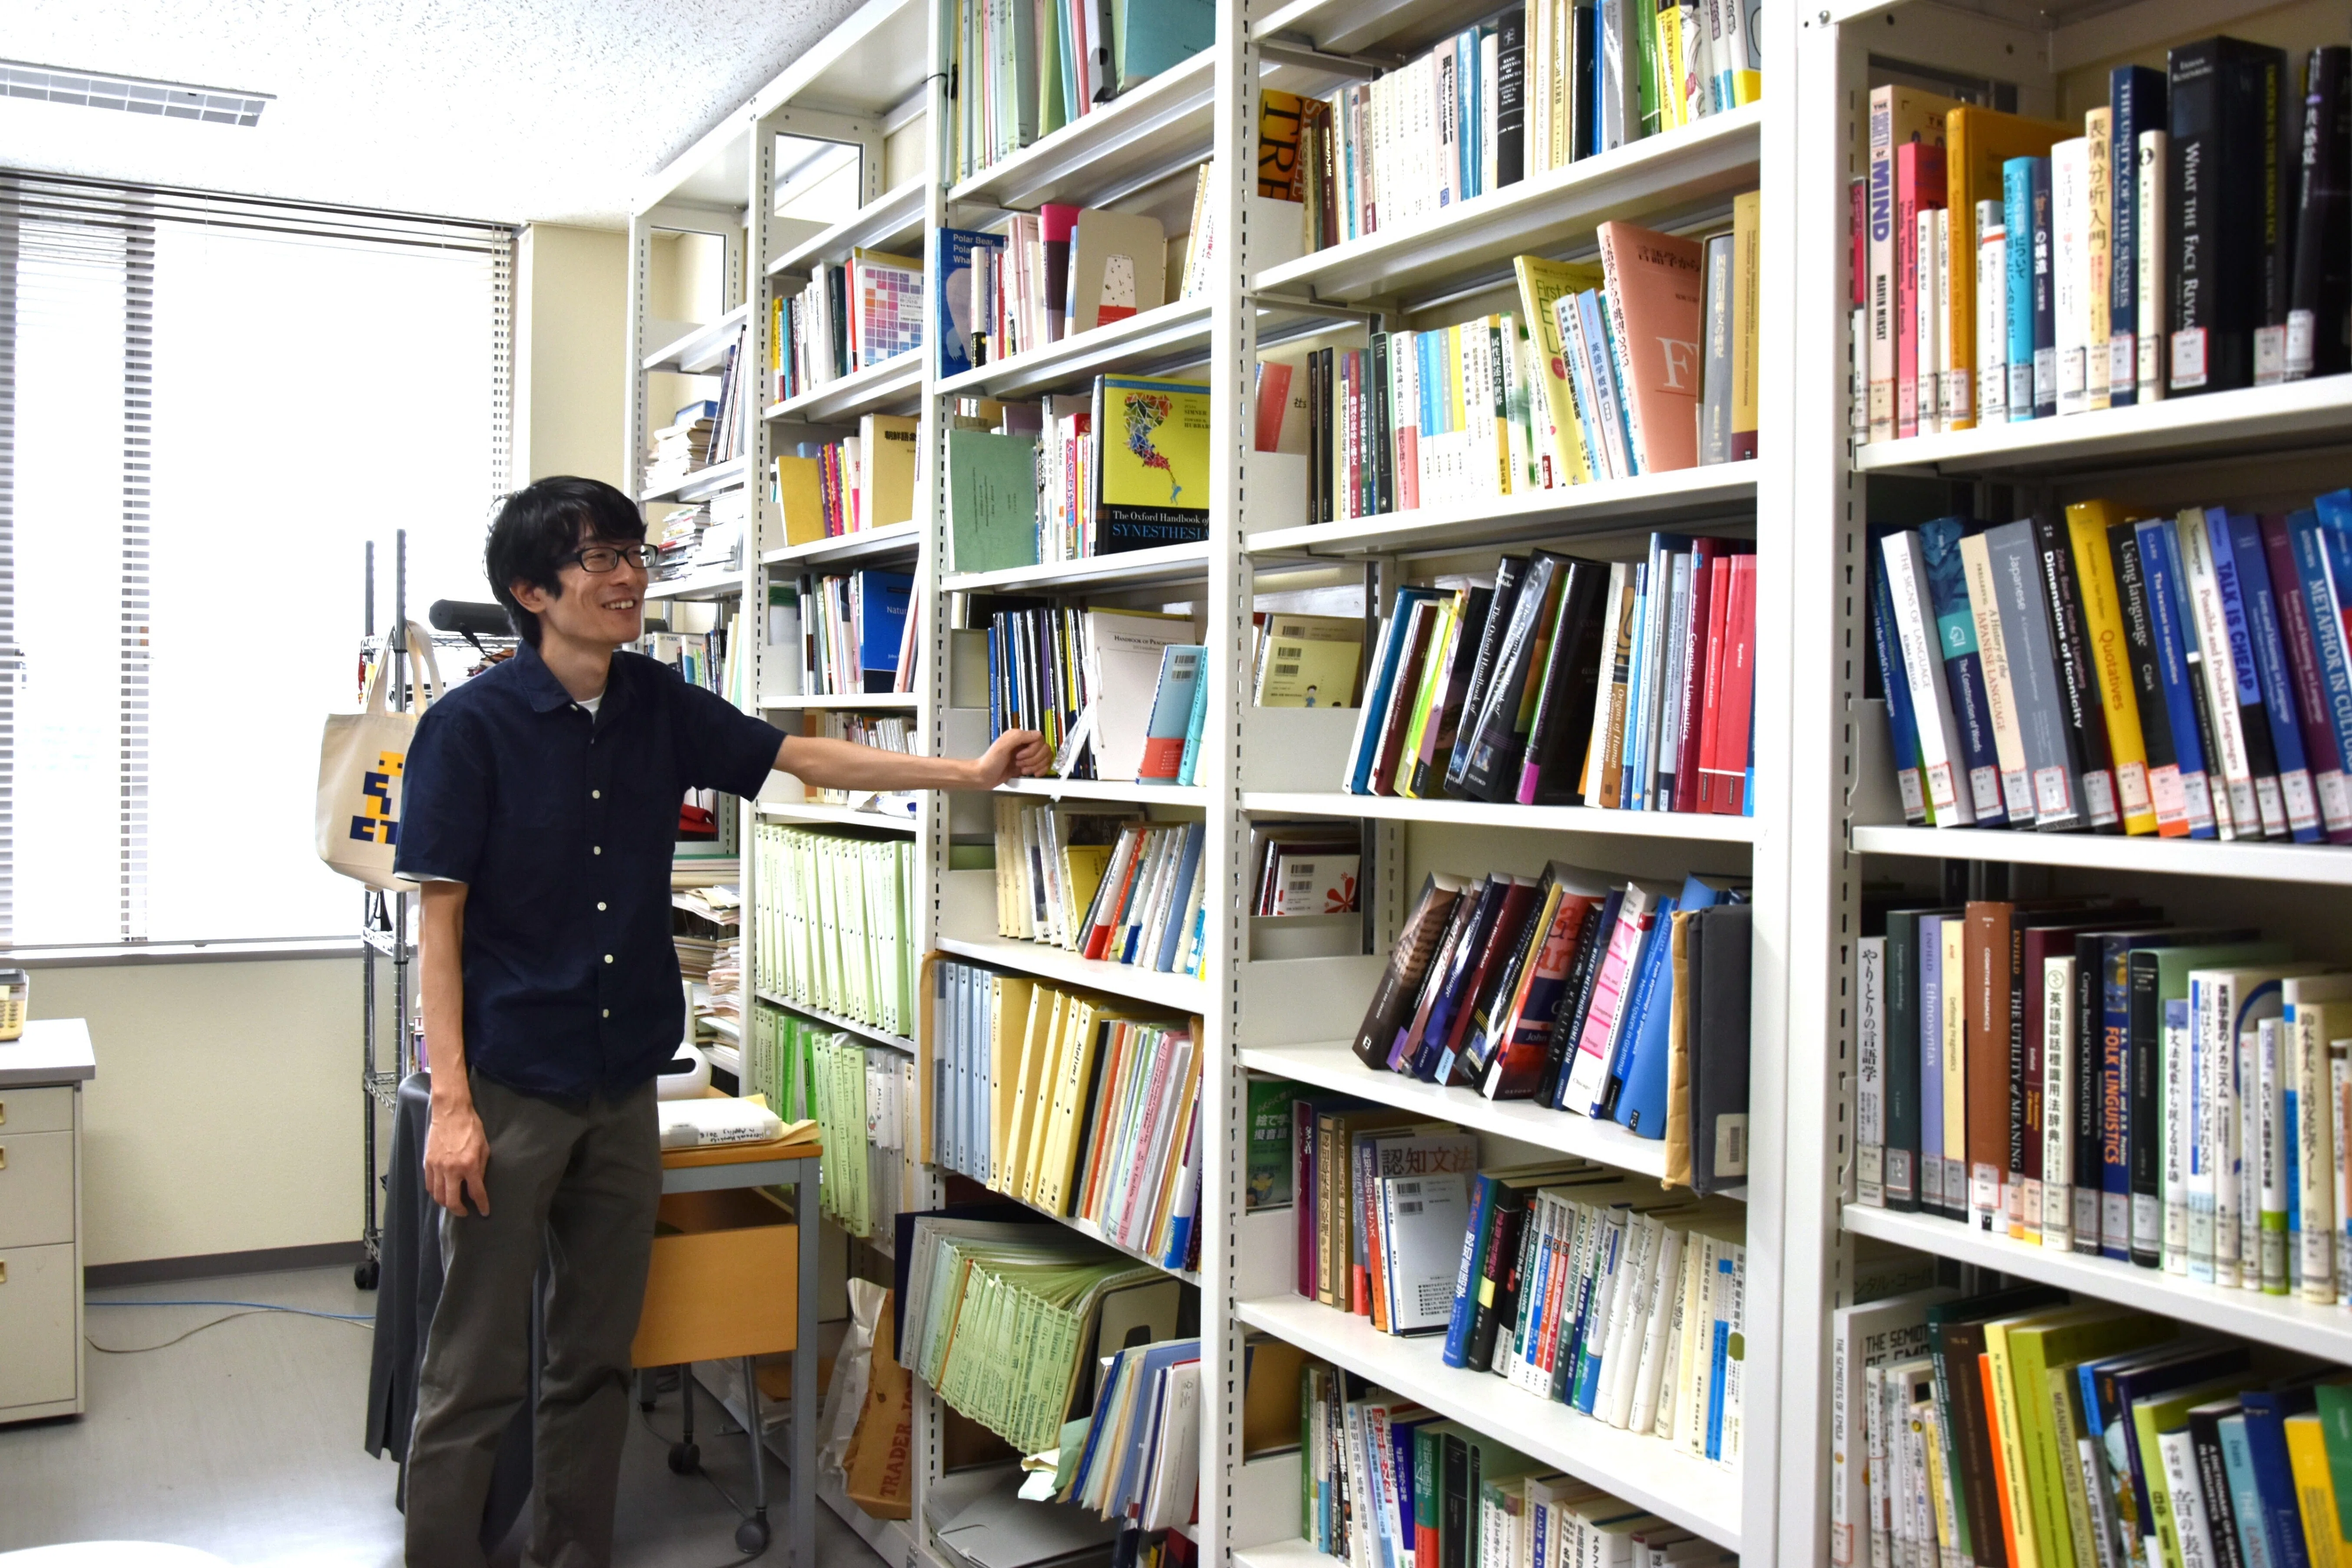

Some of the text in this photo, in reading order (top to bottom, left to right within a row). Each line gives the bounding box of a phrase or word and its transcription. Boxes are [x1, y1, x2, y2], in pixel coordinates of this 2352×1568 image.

[1872, 159, 1890, 242] MIND
[2088, 119, 2106, 251] 表情分析入門
[2120, 84, 2130, 307] THE UNITY OF THE SENSES
[953, 234, 995, 247] Polar Bear,
[953, 245, 971, 253] Pola
[953, 255, 972, 264] Wha
[2183, 142, 2201, 331] WHAT THE FACE REVEA
[1536, 280, 1561, 301] First
[1876, 275, 1887, 340] MARTIN MINSKY
[1491, 336, 1503, 406] 属性叙述の世界
[1591, 342, 1608, 401] 英語学概論
[1350, 395, 1358, 466] 動詞の意味と構文
[1112, 524, 1211, 540] SYNESTHESIA
[1113, 510, 1210, 526] The Oxford Handbook of
[1492, 606, 1502, 621] The
[2009, 554, 2026, 611] Japanese
[2120, 540, 2147, 647] Using language
[1114, 635, 1142, 645] HANDBOOK
[1484, 623, 1496, 656] Oxford
[1900, 552, 1932, 689] THE SIGNS OF LANGUAGE
[2044, 551, 2083, 729] Dimensions of Iconicity
[2217, 560, 2255, 691] TALK IS CHEAP
[2308, 578, 2343, 672] METAPHOR
[2329, 672, 2348, 693] IN
[1474, 657, 1490, 702] Handbook
[1683, 633, 1697, 740] Cognitive Linguistics
[1707, 637, 1718, 708] Grammaticalization
[1958, 658, 1968, 672] The
[1961, 673, 1975, 718] Construction
[1977, 612, 2006, 731] JAPANESE LANGUAGE
[2100, 629, 2124, 711] Quotatives
[2142, 663, 2154, 692] Clark
[1604, 693, 1617, 762] Communication
[1614, 688, 1625, 721] Origins
[1611, 734, 1621, 769] Human
[1971, 728, 1982, 753] Words
[2222, 711, 2239, 771] Languages
[2013, 929, 2021, 975] ENFIELD
[1564, 948, 1598, 1065] WHERE METAPHORS COME FROM
[1862, 948, 1879, 1082] やりとりの言語学
[1926, 982, 1938, 1068] Ethnosyntax
[2011, 989, 2022, 1017] THE
[1525, 1032, 1548, 1042] John
[2011, 1023, 2022, 1082] UTILITY
[2048, 992, 2062, 1142] 英語談話標識用法辞典
[2217, 984, 2229, 1099] 英語学習のメカニズム
[2081, 1036, 2091, 1136] SOCIOLINGUISTICS
[2105, 1026, 2120, 1164] FOLK LINGUISTICS
[1381, 1146, 1475, 1176] 認知文法
[2011, 1097, 2022, 1169] MEANING
[1319, 1132, 1330, 1237] 認知意味論の原理
[1362, 1147, 1376, 1239] 認知文法のエッセンス
[1836, 1338, 1844, 1353] THE
[1866, 1333, 1887, 1353] THE
[1836, 1356, 1844, 1400] SEMIOTICS
[1836, 1415, 1844, 1441] EMOJI
[880, 1422, 912, 1497] TRADER
